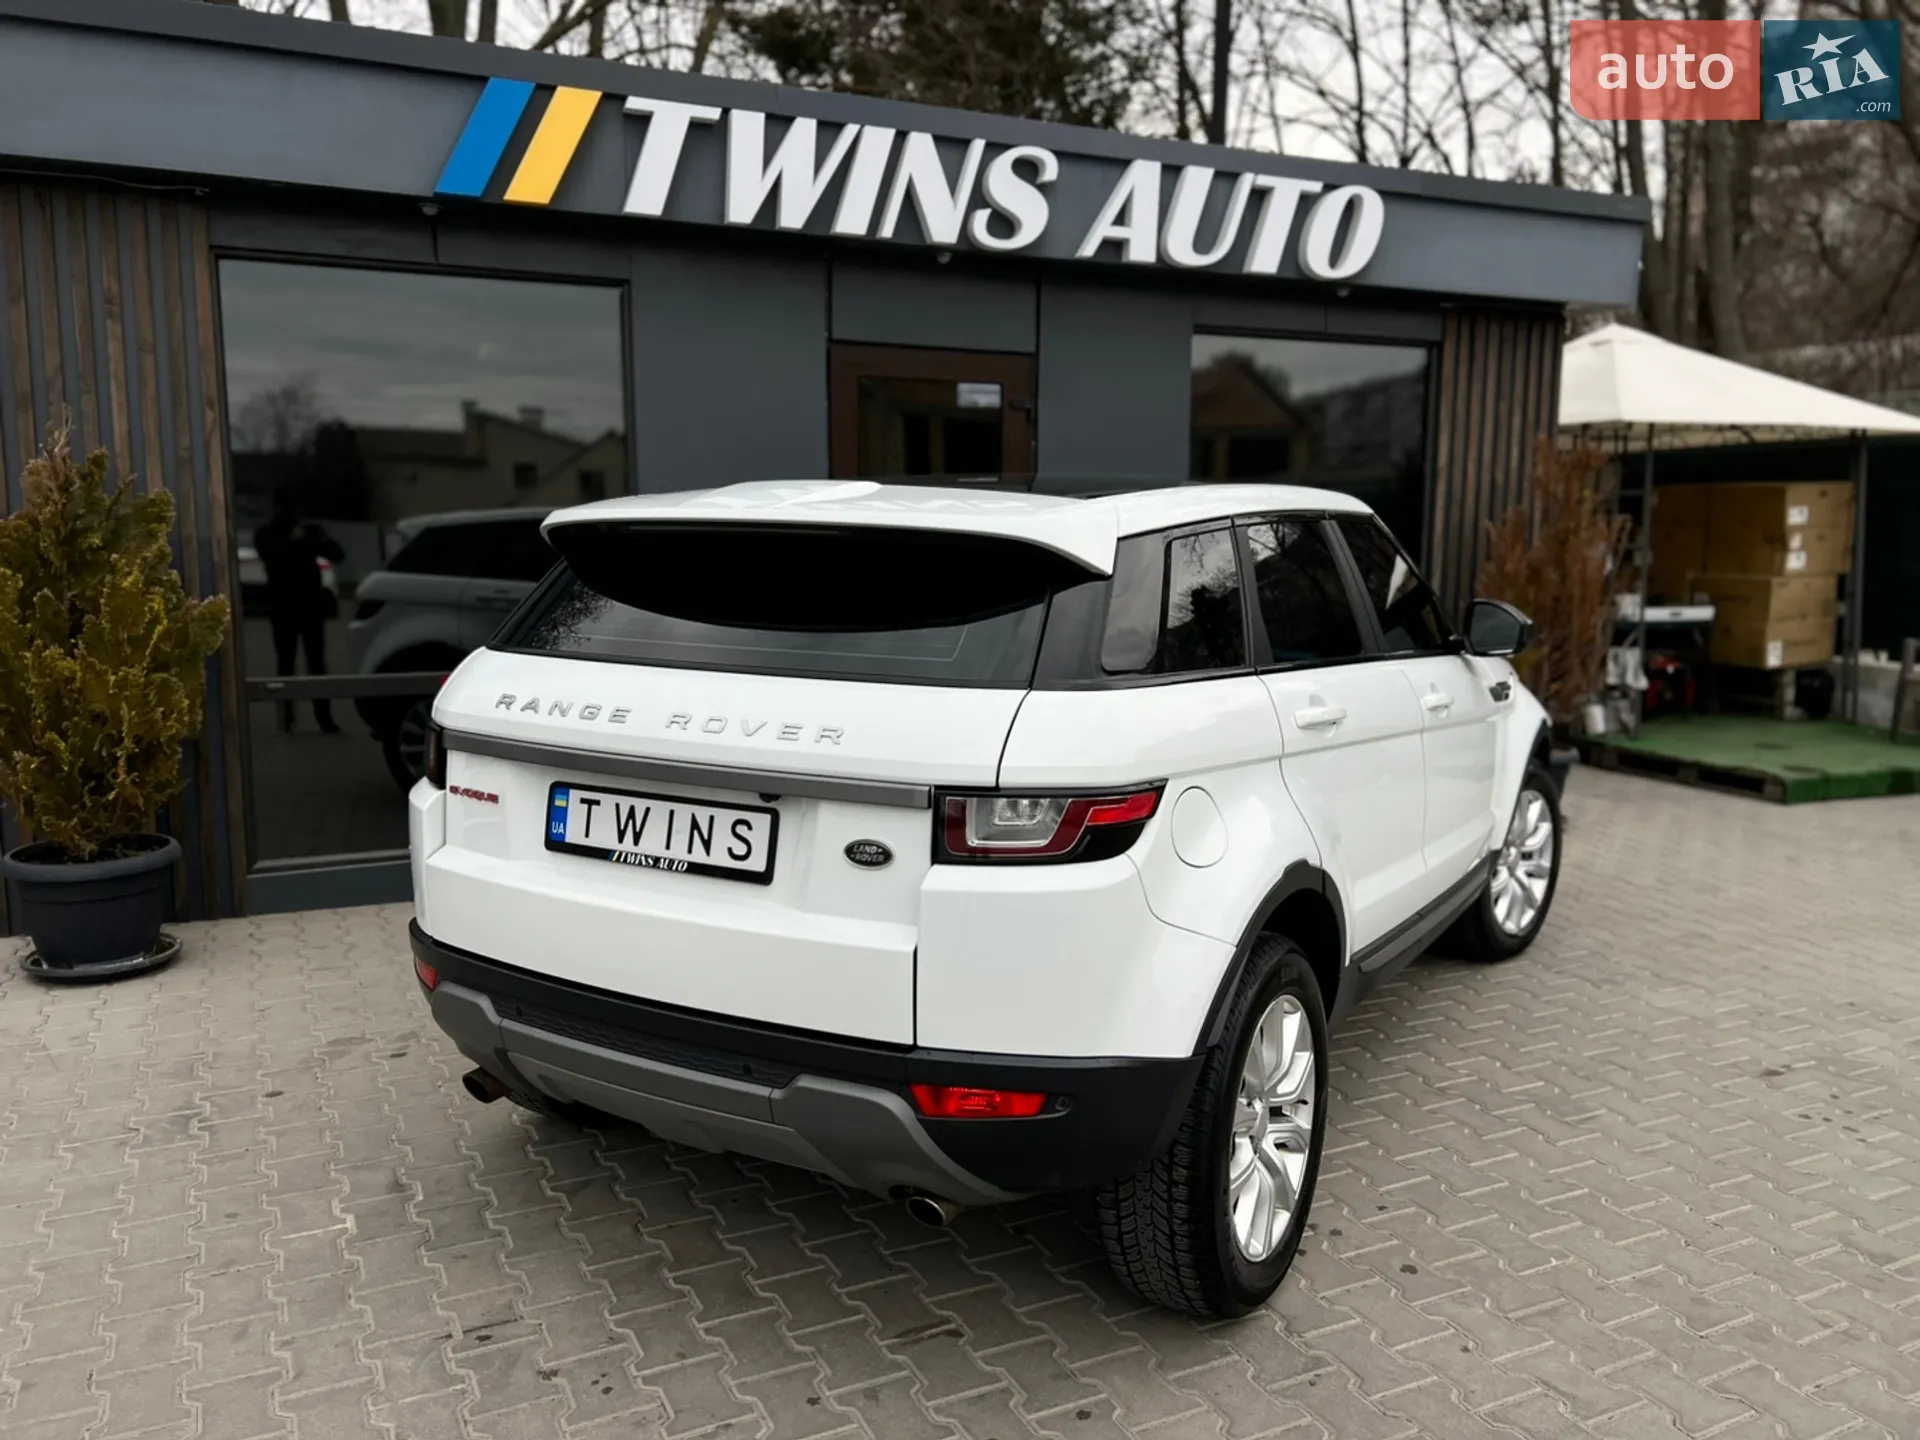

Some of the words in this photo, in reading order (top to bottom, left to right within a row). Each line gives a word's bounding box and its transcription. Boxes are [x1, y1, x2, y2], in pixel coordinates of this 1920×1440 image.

[622, 95, 1058, 251] TWINS
[1077, 158, 1386, 281] AUTO
[495, 693, 632, 724] RANGE
[665, 711, 845, 745] ROVER
[552, 821, 565, 835] UA
[620, 851, 655, 867] TWINS
[656, 857, 688, 872] AUTO
